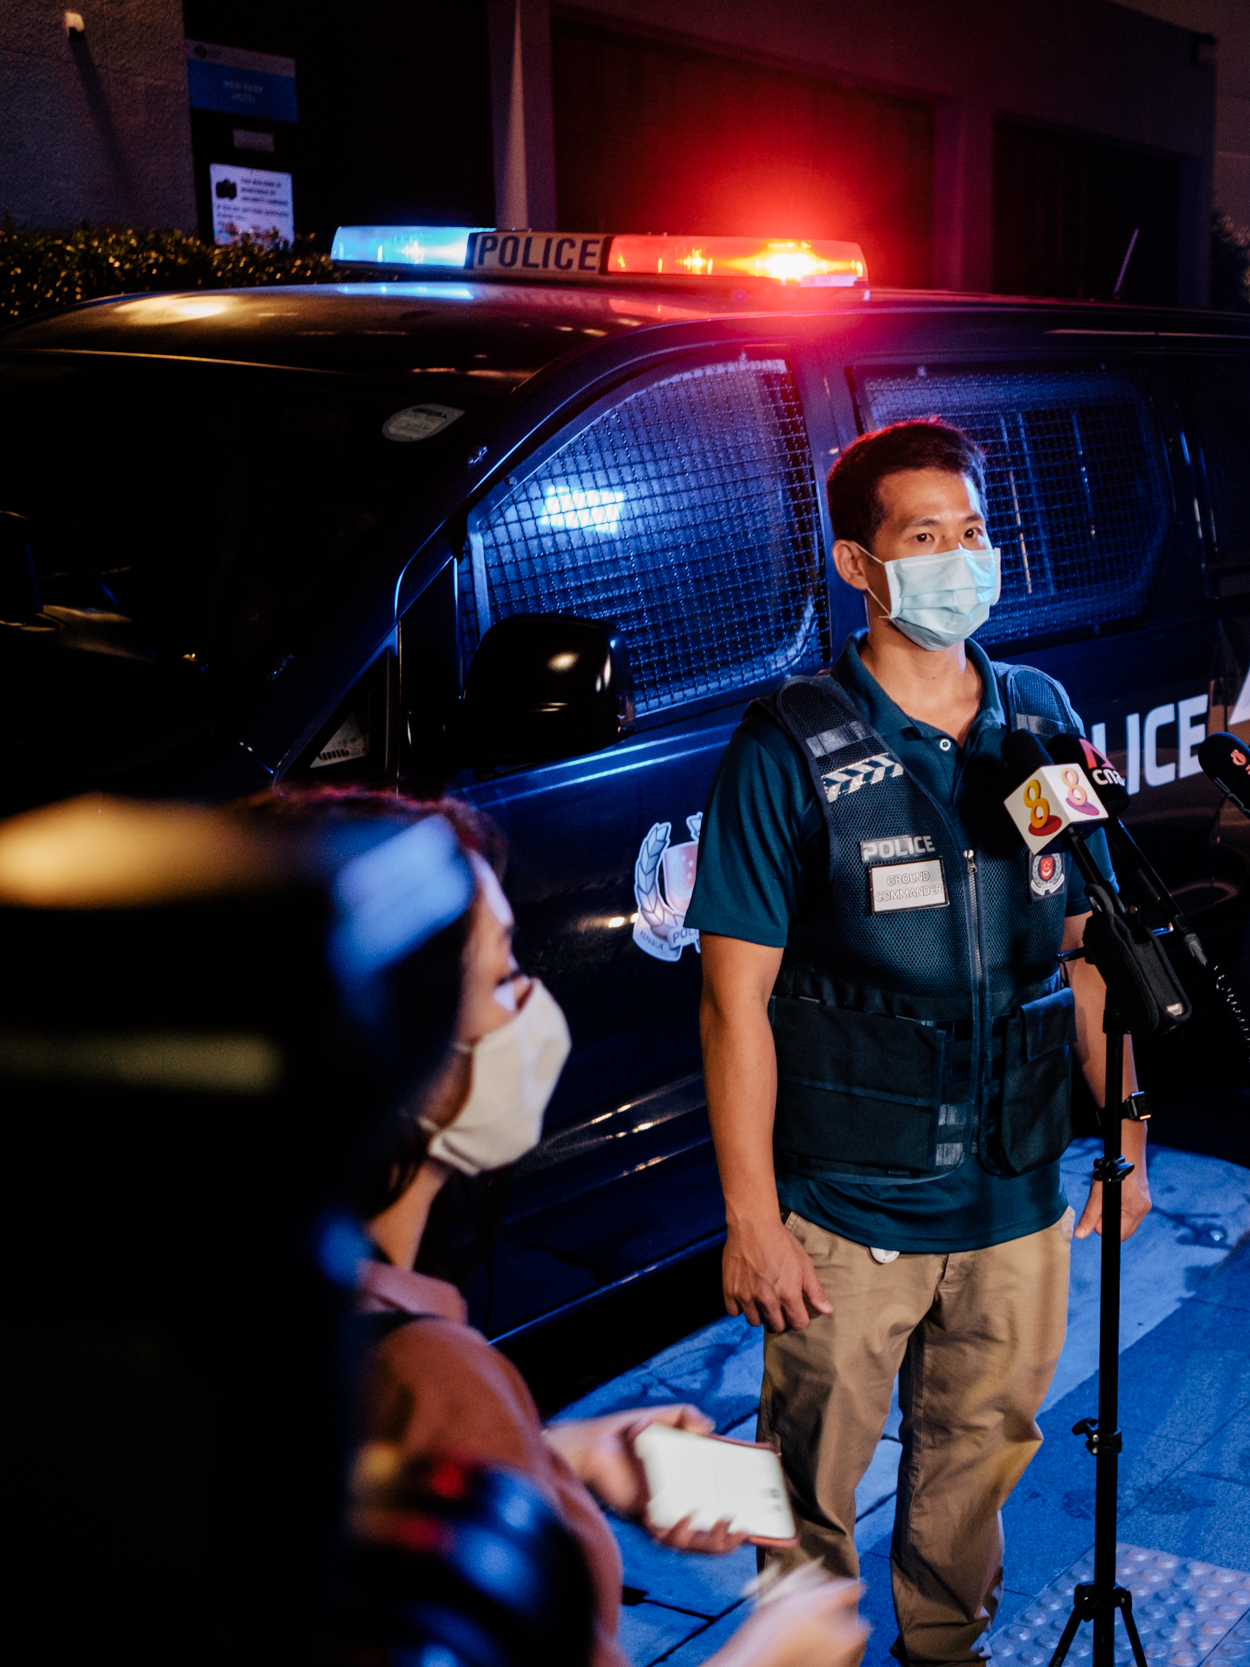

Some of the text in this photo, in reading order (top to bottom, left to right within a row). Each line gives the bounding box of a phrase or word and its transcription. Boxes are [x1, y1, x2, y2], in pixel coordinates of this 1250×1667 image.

[478, 236, 599, 270] POLICE
[1091, 693, 1208, 797] LICE
[1023, 778, 1050, 829] 8
[1061, 767, 1087, 806] 8
[862, 835, 936, 861] POLICE
[875, 883, 942, 902] COMMANDER
[887, 870, 930, 886] GROUND
